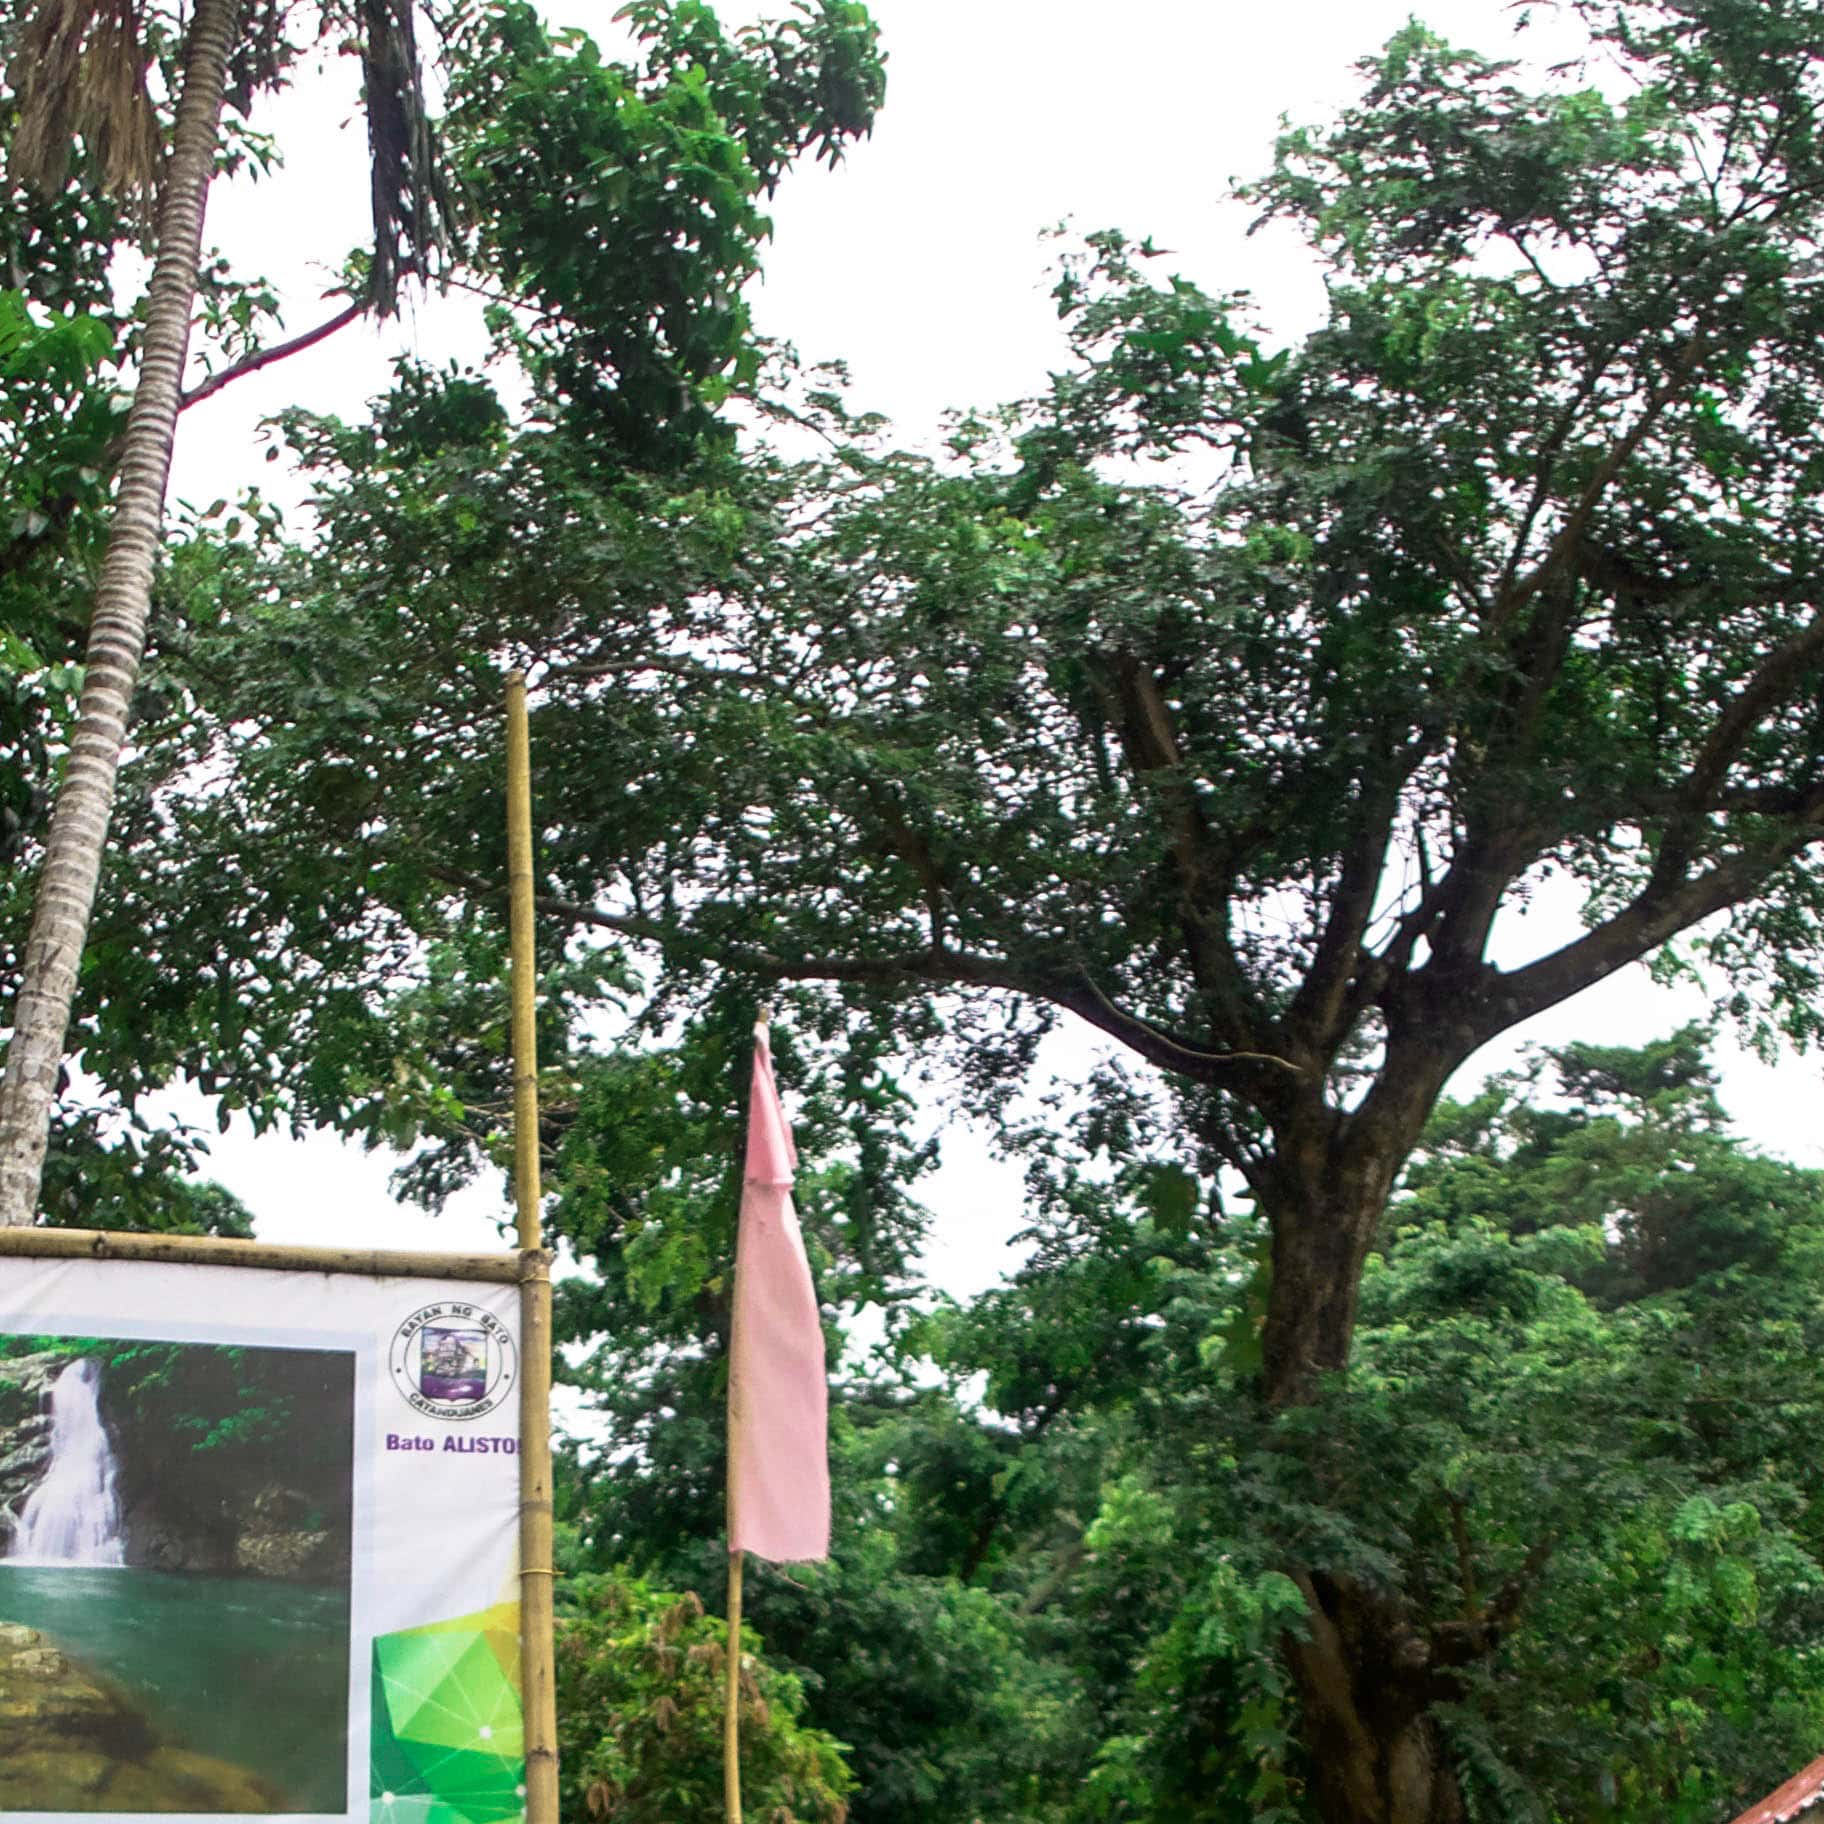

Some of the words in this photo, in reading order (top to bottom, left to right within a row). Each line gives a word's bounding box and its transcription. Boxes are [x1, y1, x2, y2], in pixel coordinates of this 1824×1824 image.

[401, 1307, 442, 1338] BAYAN
[451, 1304, 472, 1317] NG
[480, 1314, 509, 1345] BATO
[386, 1434, 434, 1451] Bato
